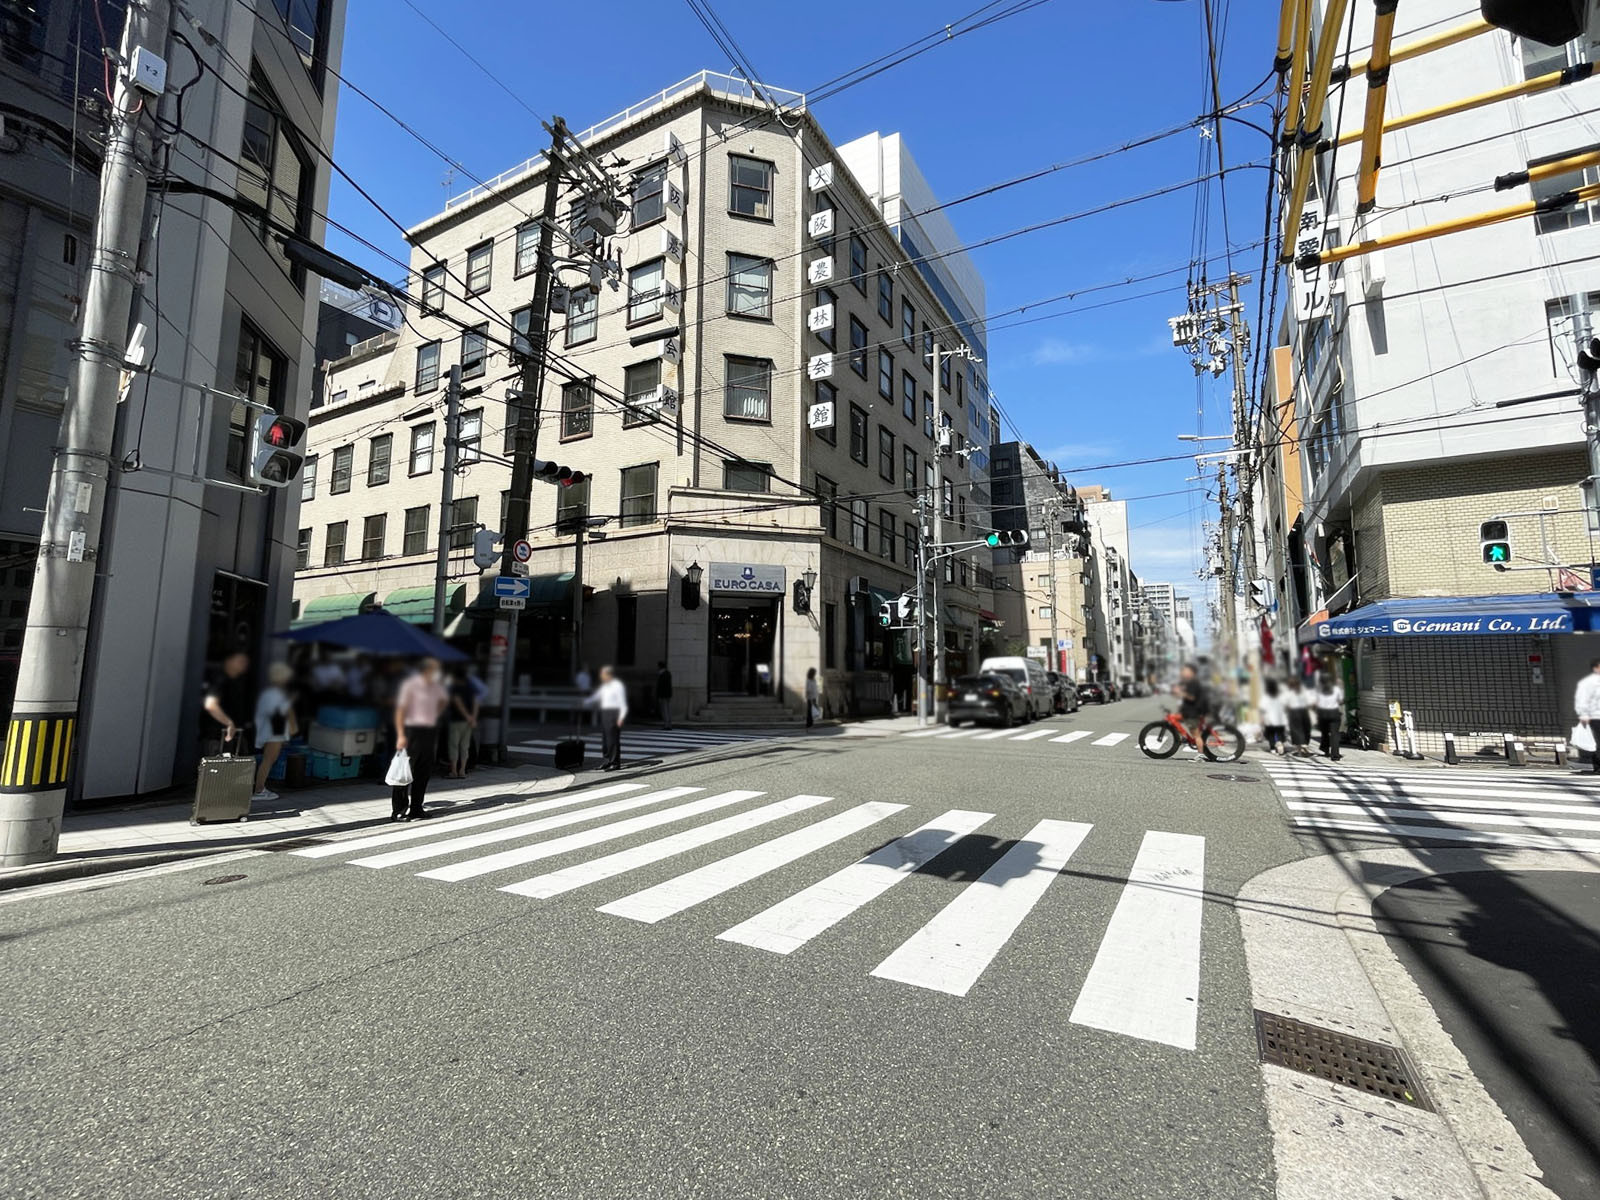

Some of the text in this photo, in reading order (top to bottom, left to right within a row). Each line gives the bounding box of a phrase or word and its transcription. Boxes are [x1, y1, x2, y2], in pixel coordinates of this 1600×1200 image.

[812, 167, 830, 426] 大阪農林会館
[1357, 626, 1389, 634] ジェマーニ
[1413, 618, 1480, 633] Gemani
[1487, 617, 1521, 633] Co.,
[1527, 614, 1568, 631] Ltd.
